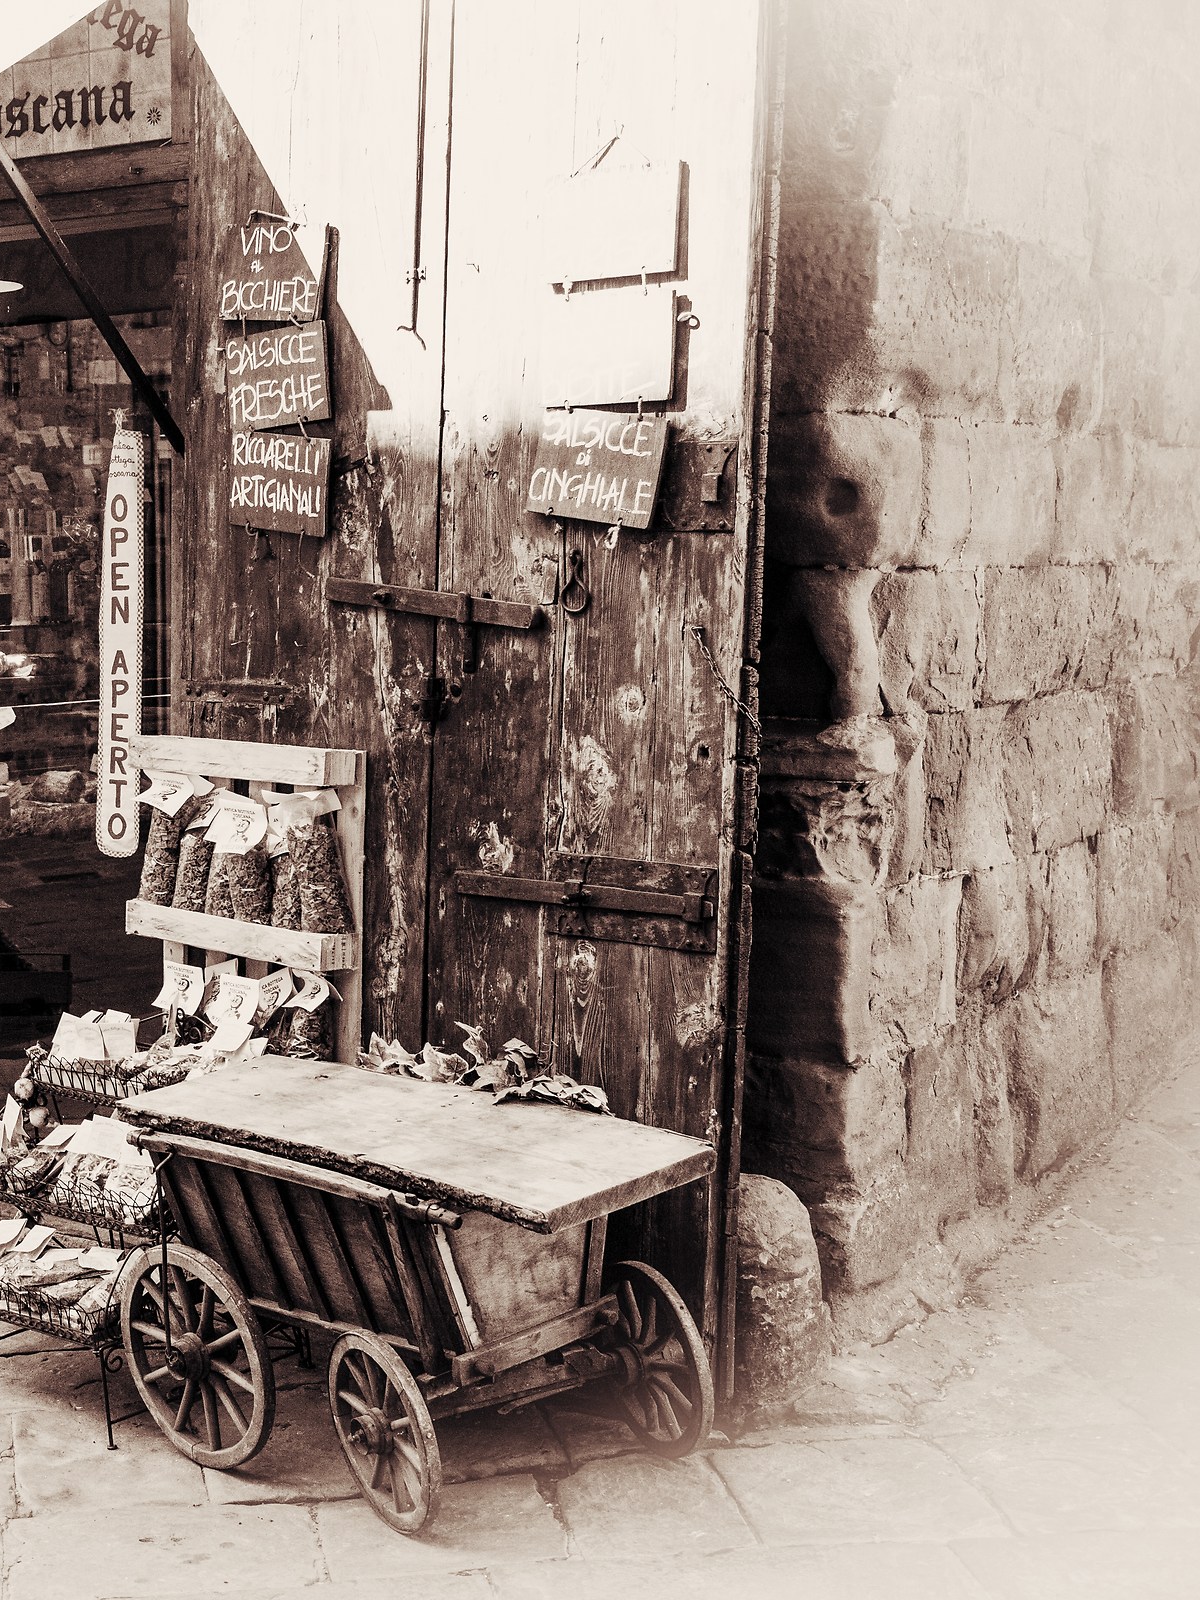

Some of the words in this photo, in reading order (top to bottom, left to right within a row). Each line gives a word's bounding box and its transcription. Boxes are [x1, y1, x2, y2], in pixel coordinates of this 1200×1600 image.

[241, 226, 293, 255] VINO
[250, 259, 264, 273] AL
[220, 277, 318, 315] BICCHIERE
[227, 331, 318, 376] SALSICCE
[229, 374, 324, 425] FRESCHE
[233, 433, 320, 476] RICCIARELLI
[542, 411, 654, 457] SALSICCE
[230, 474, 321, 518] ARTIGIANALI
[528, 467, 652, 515] CINGHIALE
[110, 493, 131, 625] OPEN
[107, 649, 130, 840] APERTO
